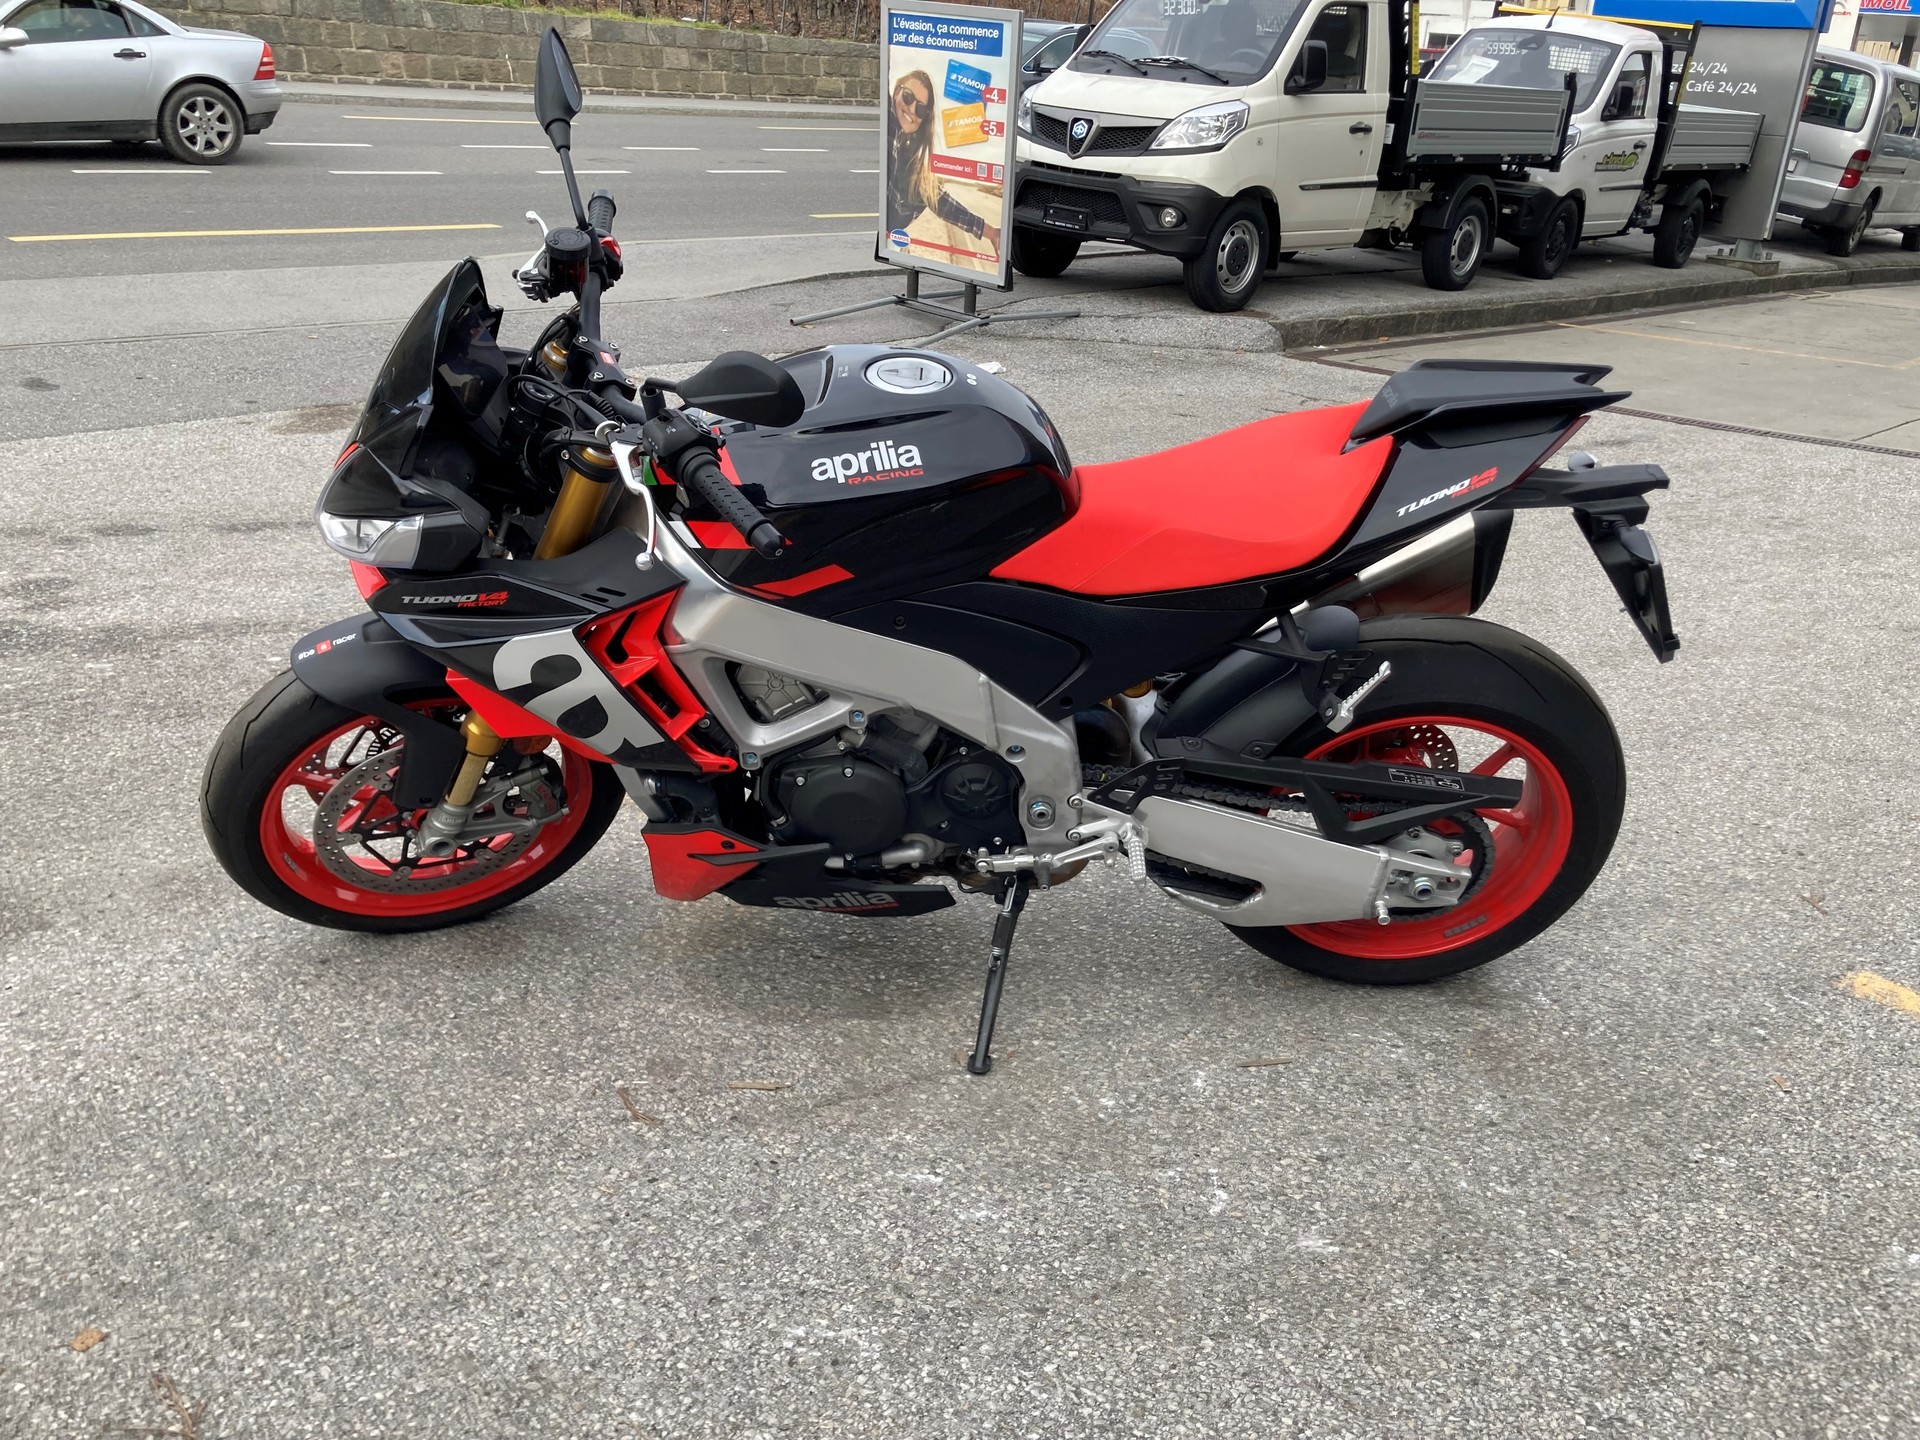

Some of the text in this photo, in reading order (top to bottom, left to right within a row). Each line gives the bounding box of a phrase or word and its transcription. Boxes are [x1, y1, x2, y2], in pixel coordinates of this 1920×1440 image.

[937, 23, 948, 35] ça
[949, 26, 999, 39] commence
[893, 33, 906, 44] par
[908, 33, 925, 45] des
[1689, 61, 1728, 76] 24/24
[1686, 80, 1715, 93] Café
[1717, 81, 1758, 96] 24/24
[933, 160, 964, 172] Commander
[811, 439, 923, 484] aprilia
[848, 468, 925, 486] RACING
[457, 600, 508, 608] FACTORY
[332, 633, 357, 646] racer
[773, 891, 897, 910] aprilia
